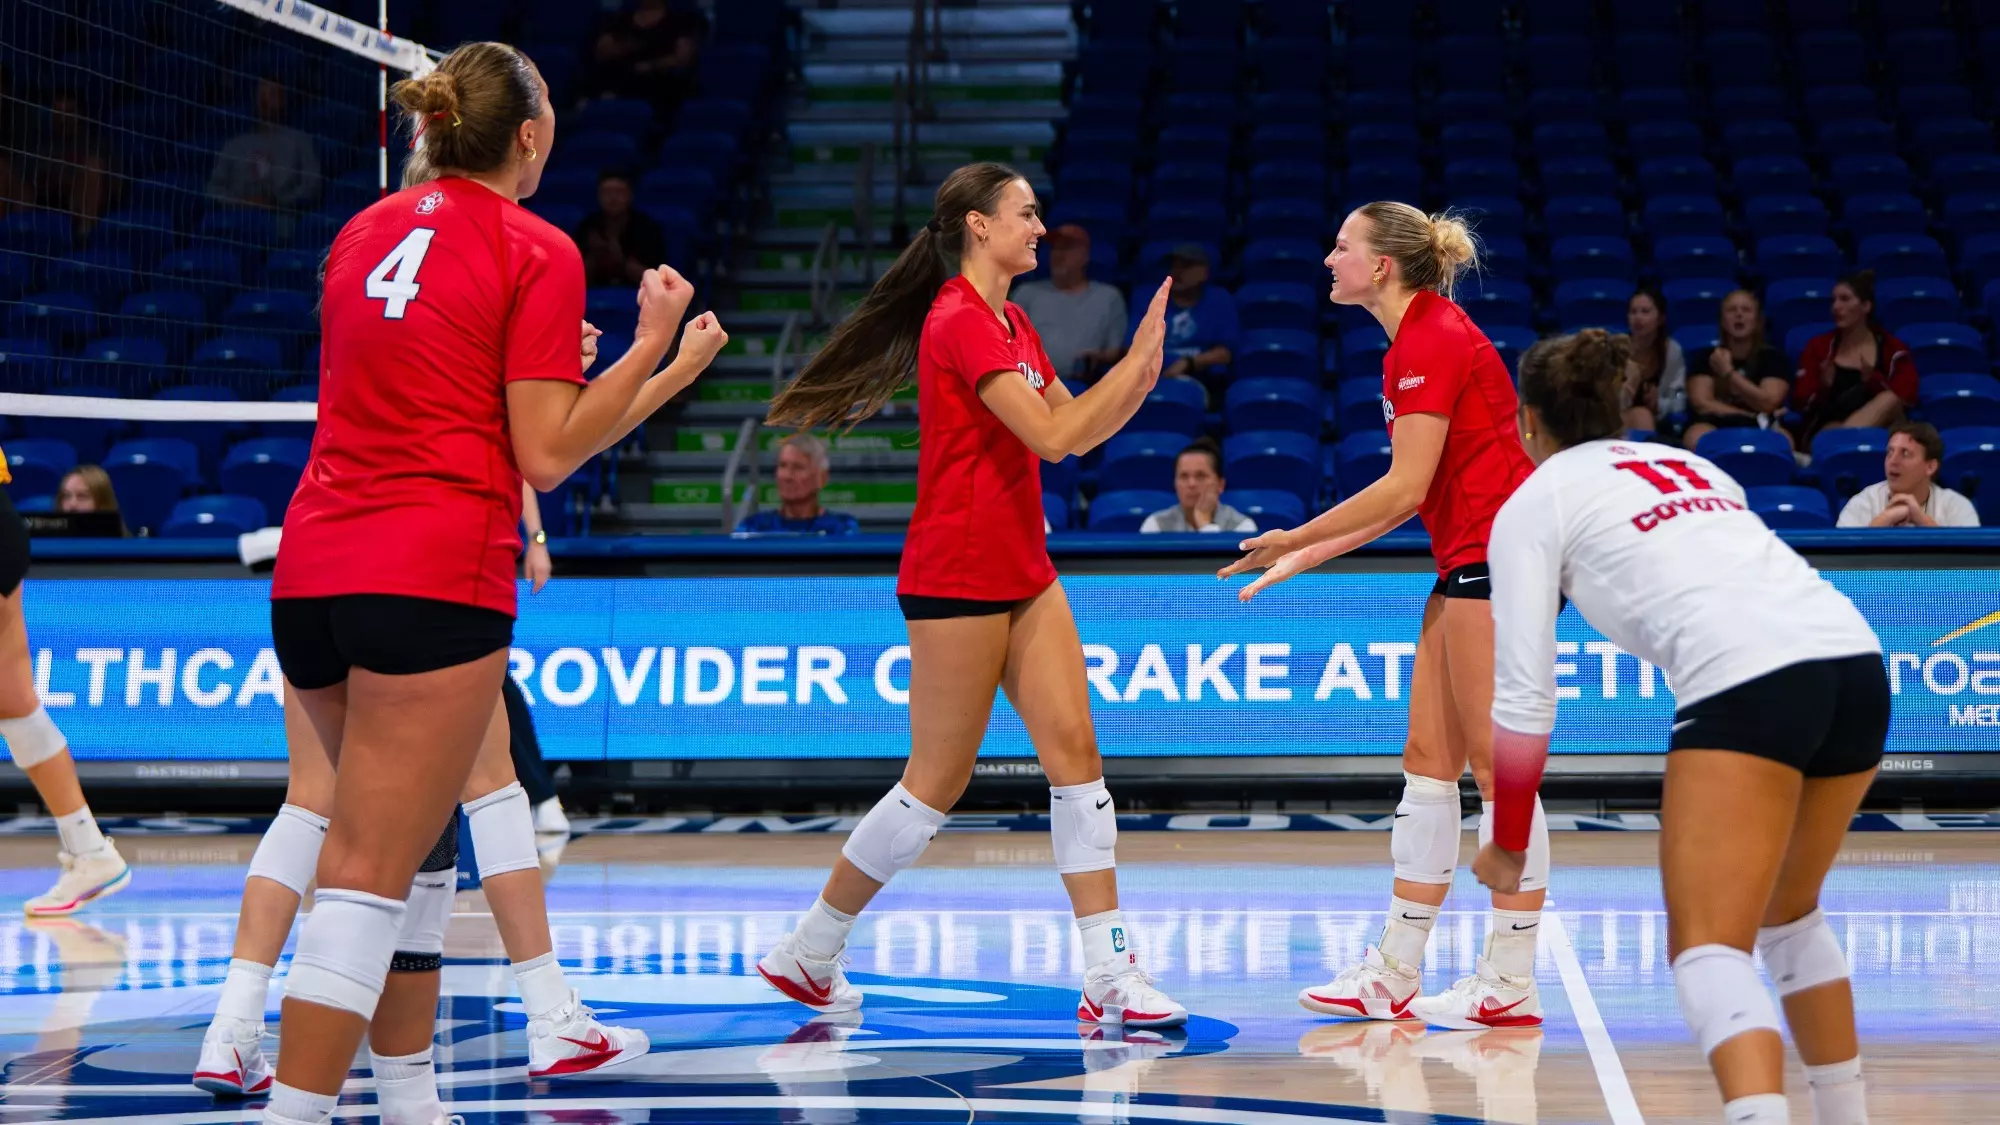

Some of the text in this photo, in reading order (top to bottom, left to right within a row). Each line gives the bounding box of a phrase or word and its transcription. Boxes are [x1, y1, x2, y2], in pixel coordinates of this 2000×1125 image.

[365, 227, 437, 320] 4
[1611, 459, 1713, 494] 11
[34, 647, 285, 707] LTHCA
[509, 645, 848, 706] ROVIDER
[874, 645, 911, 705] O
[1082, 642, 1293, 702] RAKE
[1890, 650, 2000, 695] roa
[974, 763, 1042, 776] DAKTRO
[1881, 759, 1933, 770] ONICS
